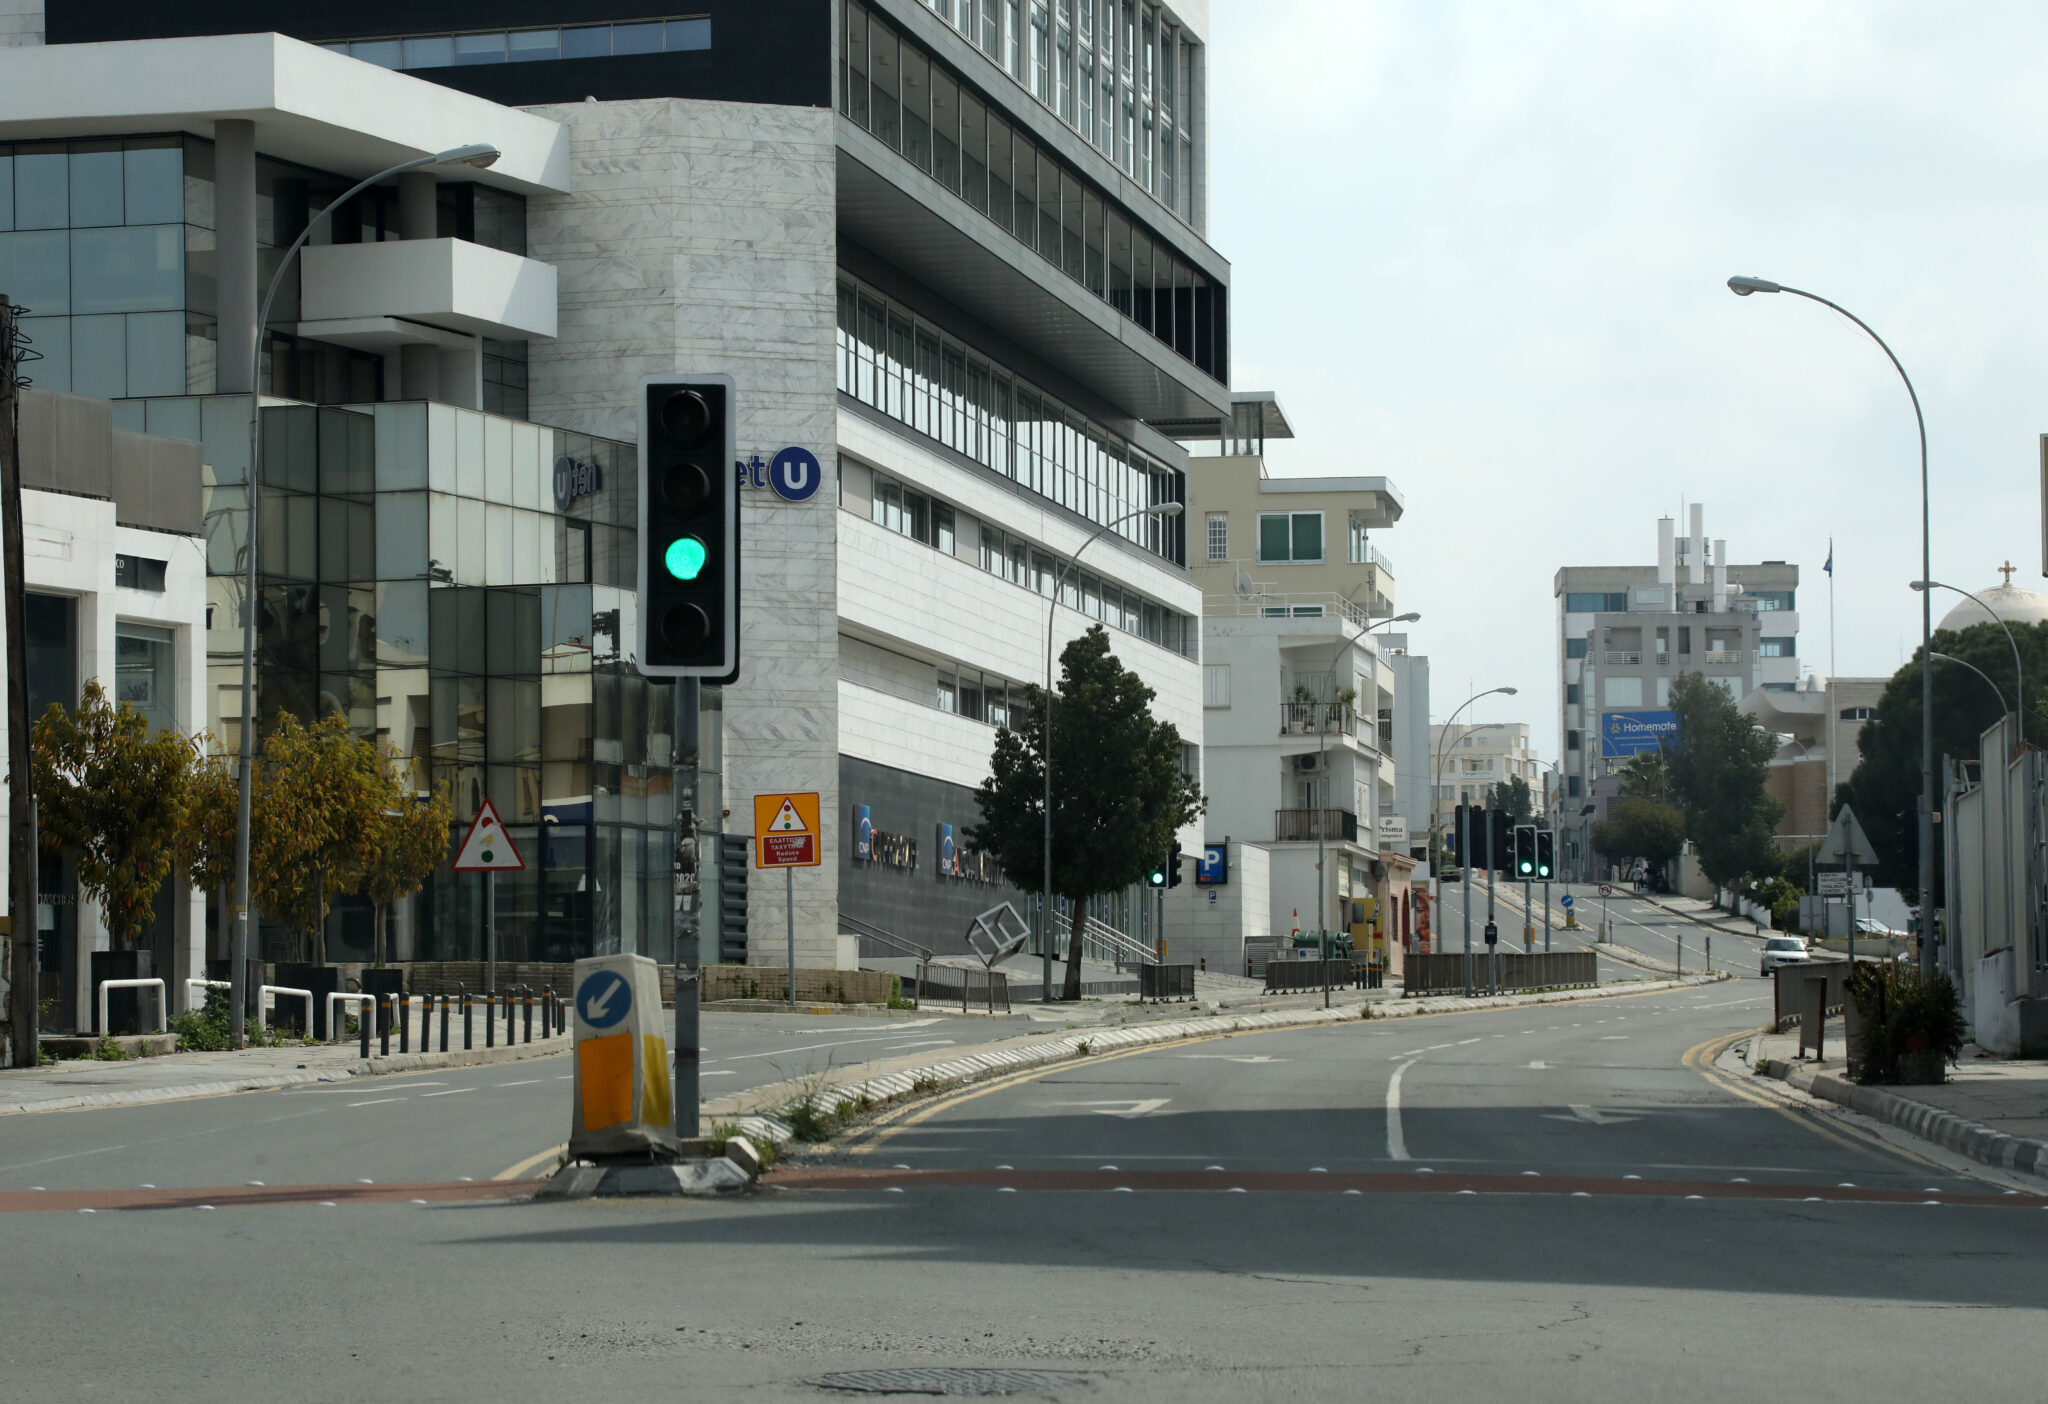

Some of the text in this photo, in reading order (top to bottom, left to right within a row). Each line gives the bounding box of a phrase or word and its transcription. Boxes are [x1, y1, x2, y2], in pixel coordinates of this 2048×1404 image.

[1623, 721, 1677, 733] Homemate
[858, 841, 870, 854] CNP
[942, 858, 952, 870] CNP
[1204, 850, 1220, 871] P
